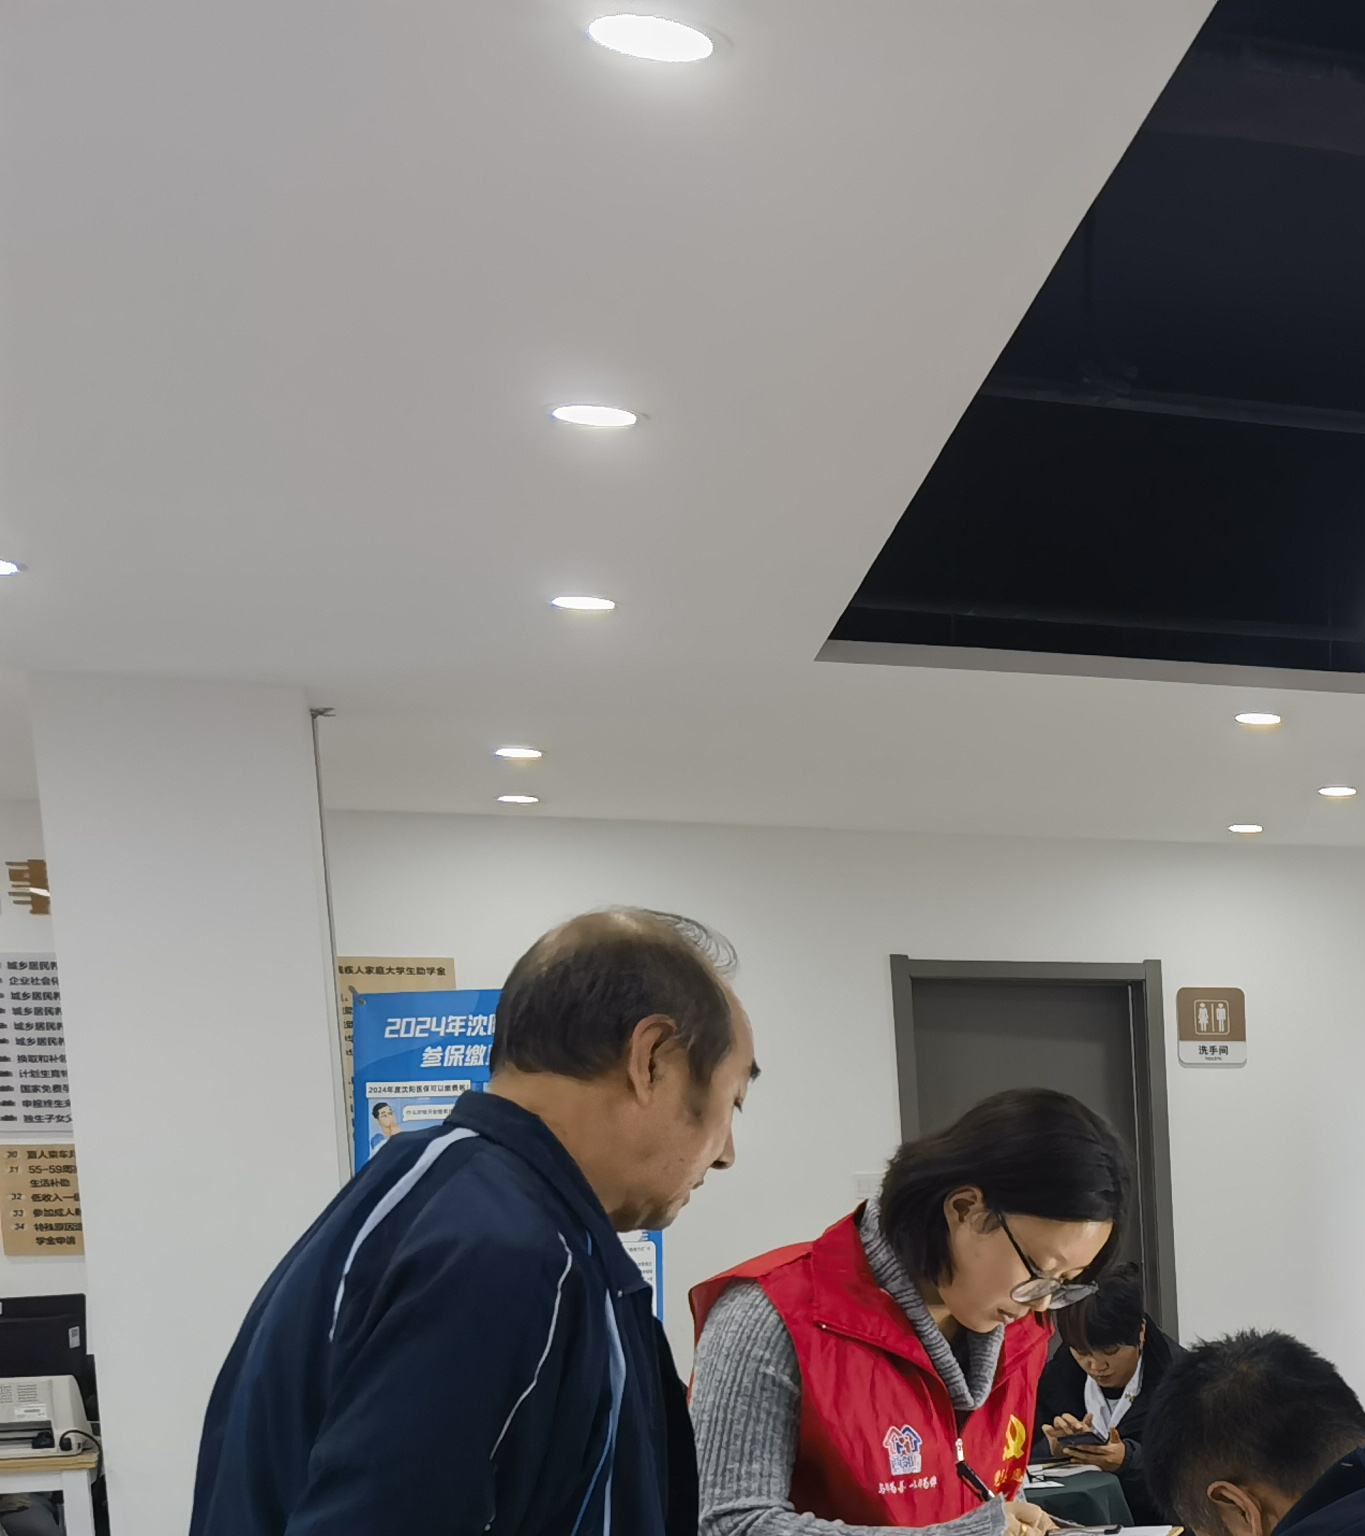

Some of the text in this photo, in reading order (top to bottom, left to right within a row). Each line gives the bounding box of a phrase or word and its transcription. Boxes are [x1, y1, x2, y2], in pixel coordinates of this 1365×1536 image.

[420, 1045, 491, 1067] 参保缴
[1198, 1045, 1229, 1055] 洗手间
